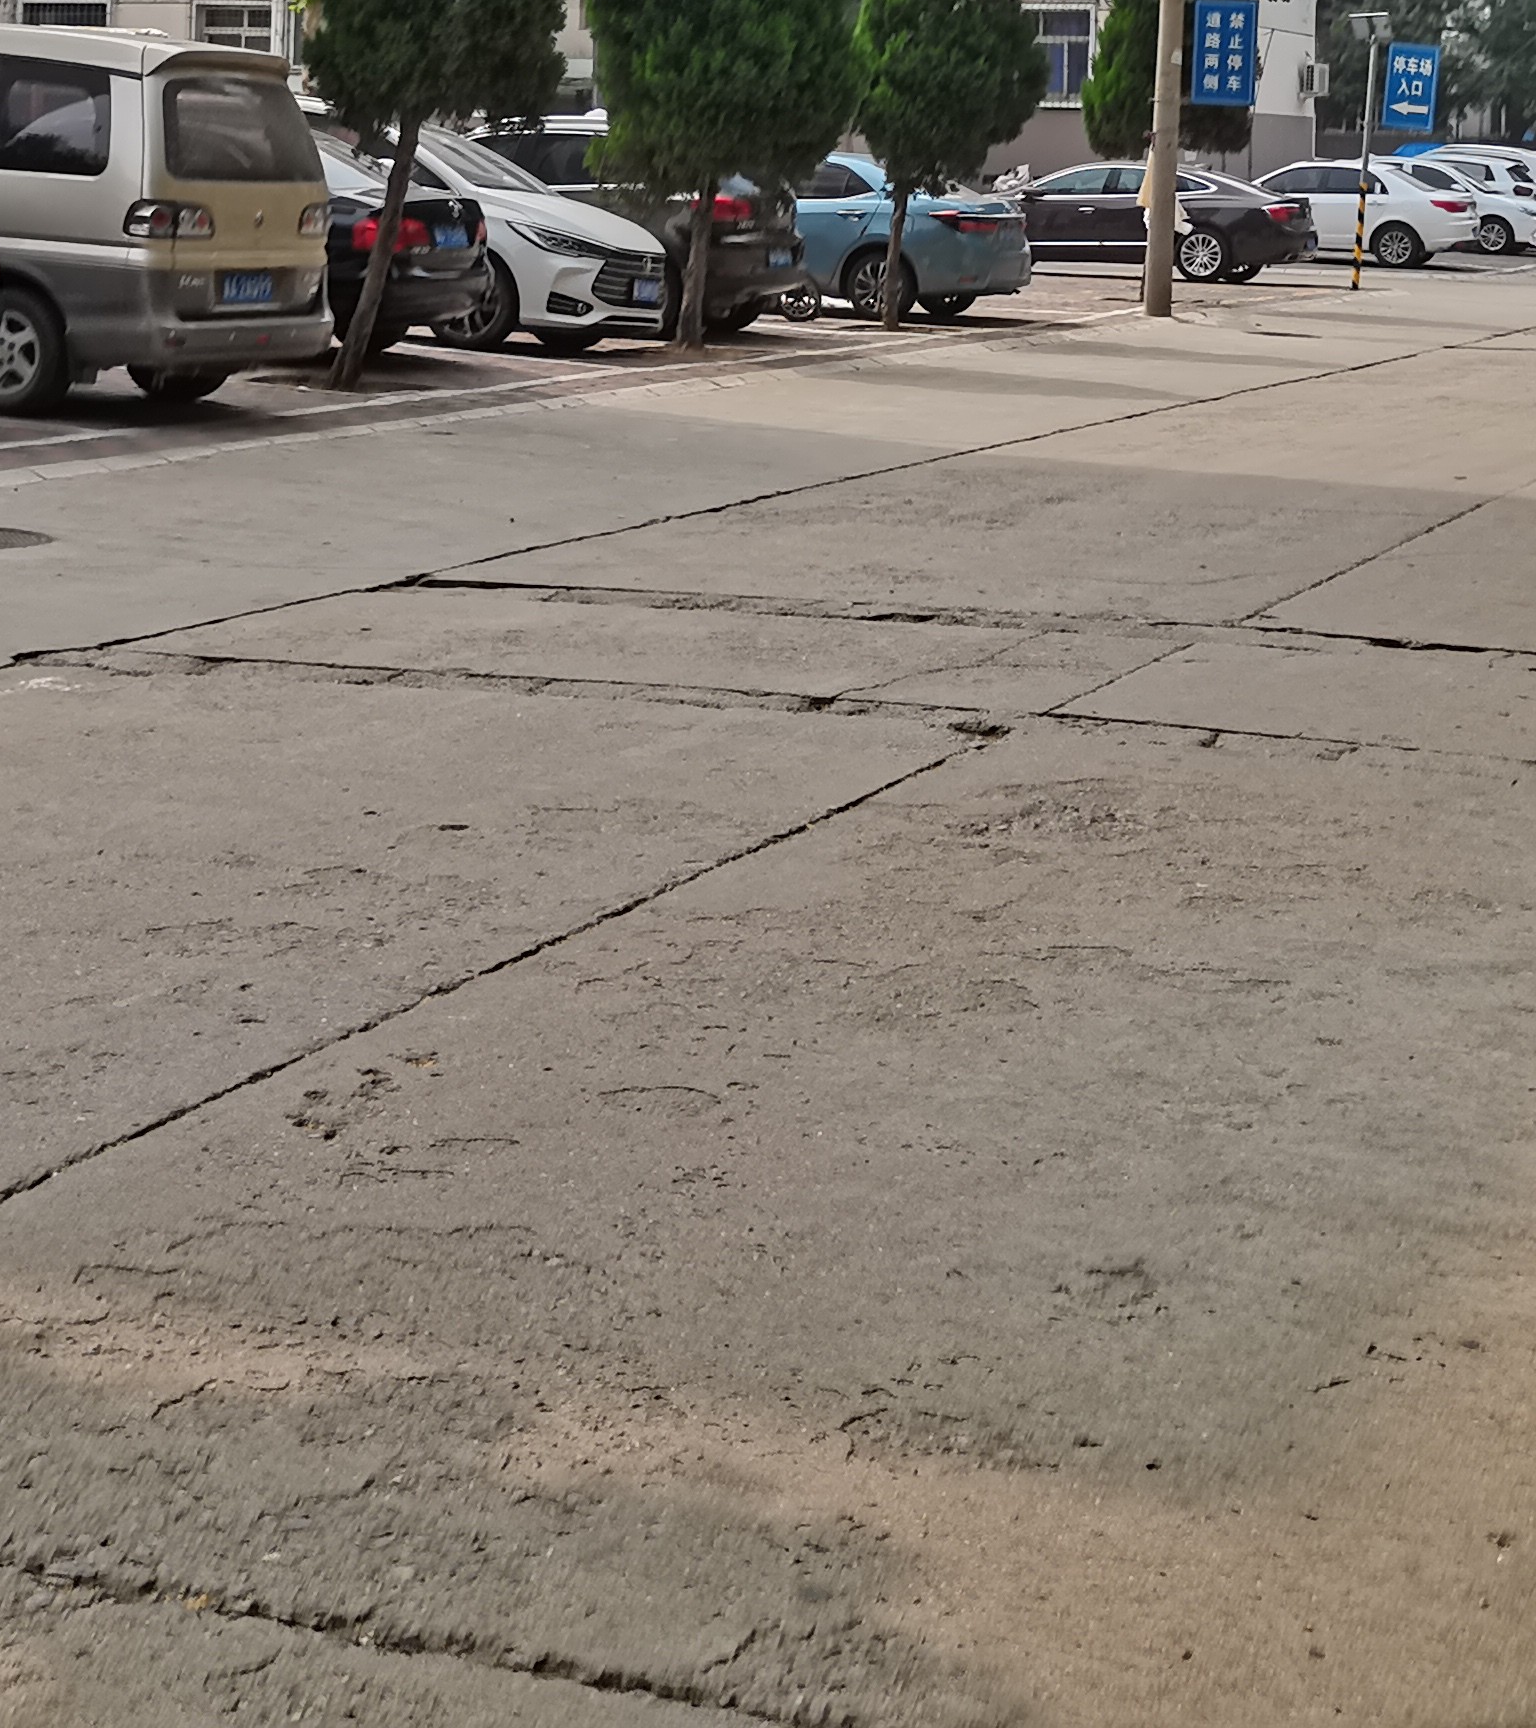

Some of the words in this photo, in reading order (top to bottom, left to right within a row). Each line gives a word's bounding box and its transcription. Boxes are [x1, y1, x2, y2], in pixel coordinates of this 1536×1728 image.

[1203, 11, 1221, 93] 道路两侧
[1226, 12, 1245, 92] 禁止停车
[1393, 55, 1433, 77] 停车场
[1396, 77, 1423, 96] 入口
